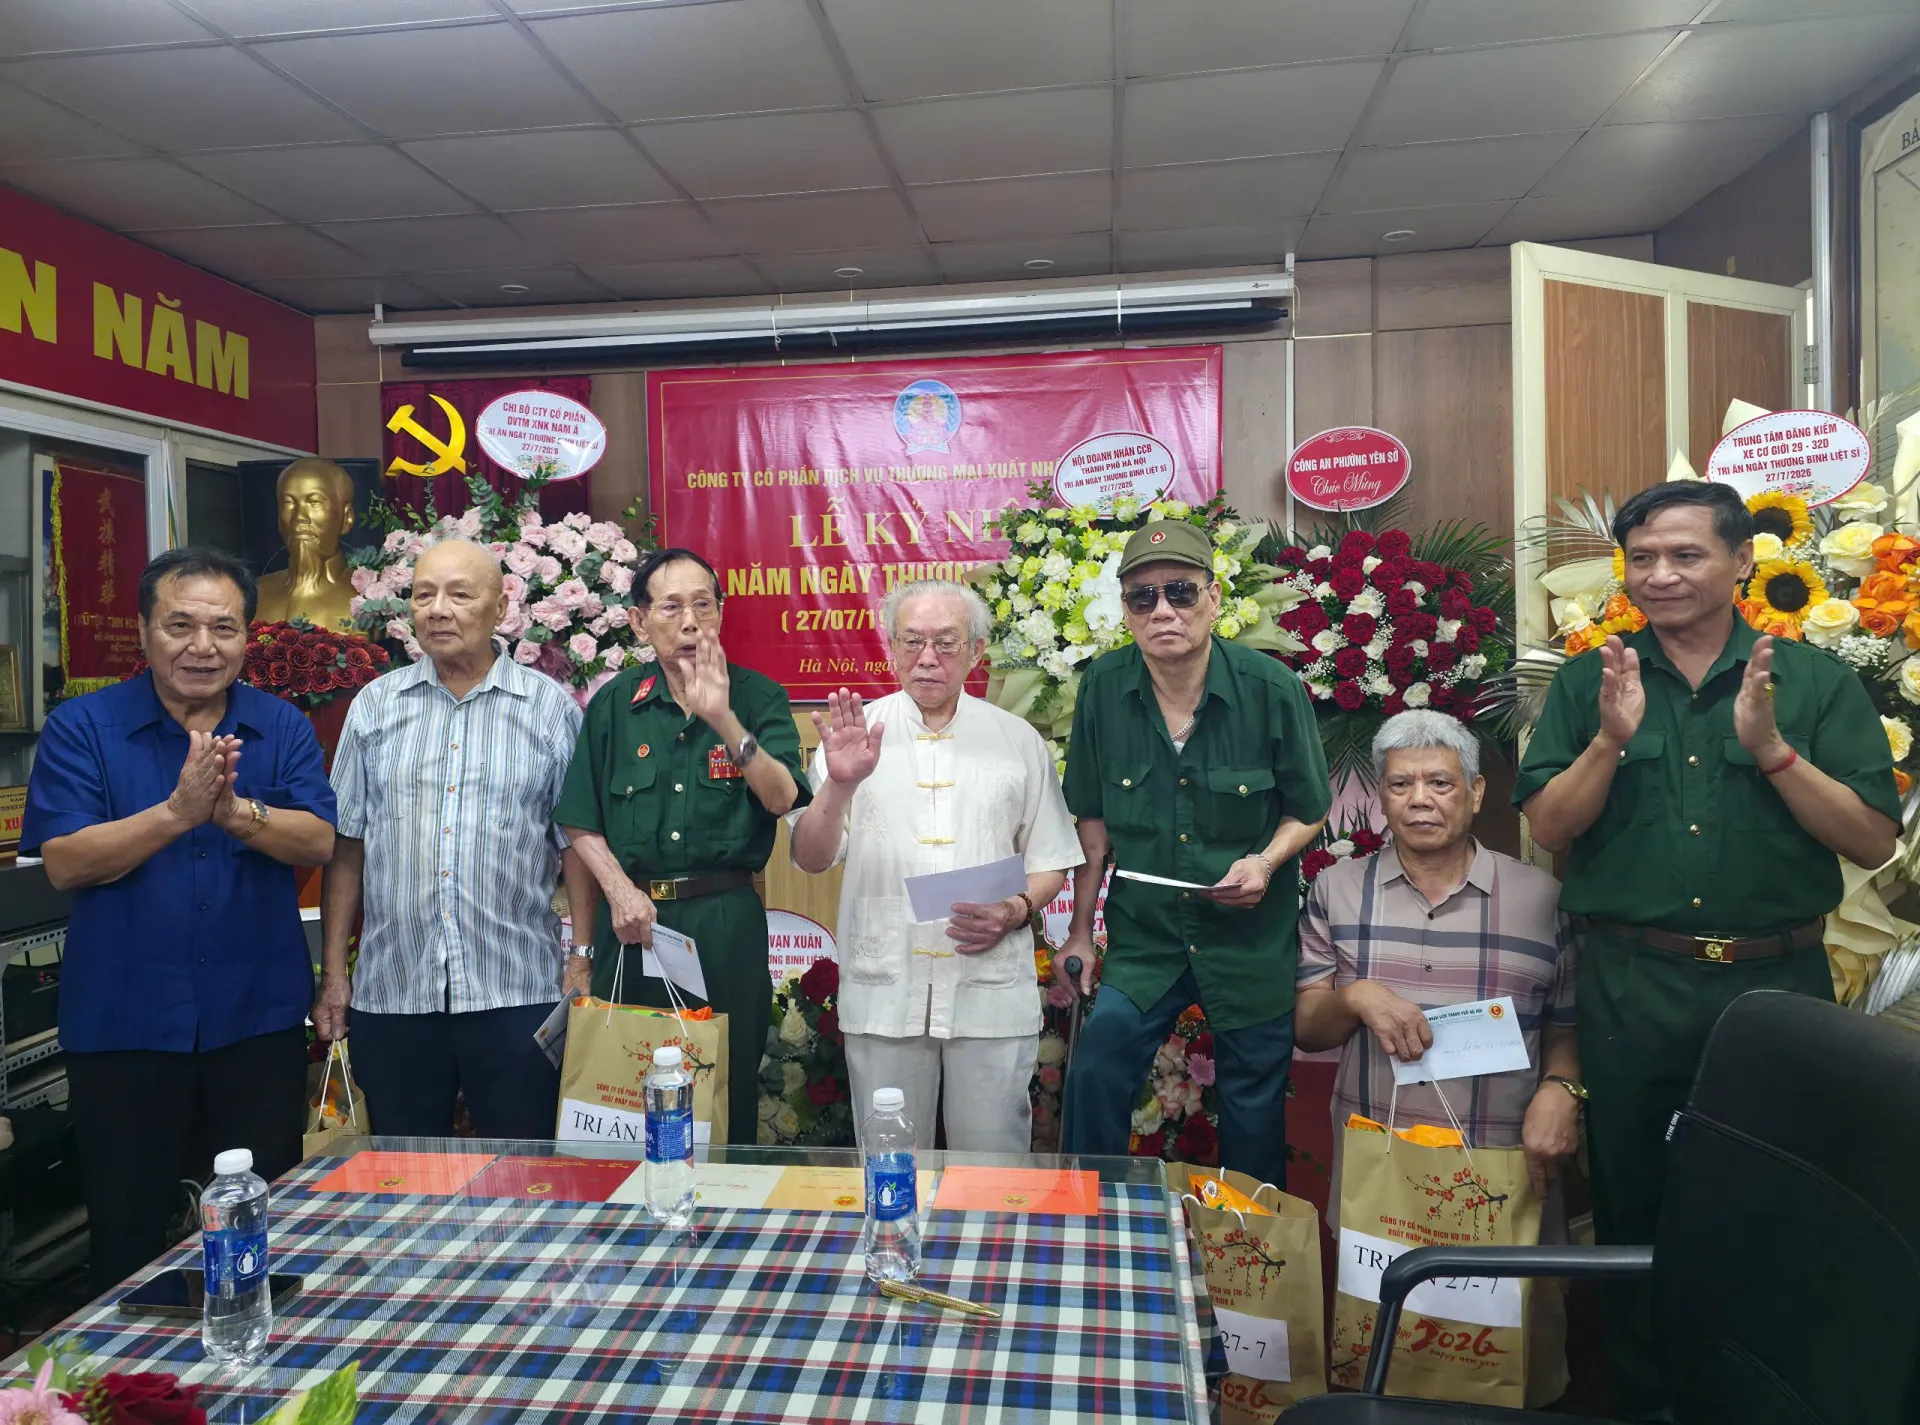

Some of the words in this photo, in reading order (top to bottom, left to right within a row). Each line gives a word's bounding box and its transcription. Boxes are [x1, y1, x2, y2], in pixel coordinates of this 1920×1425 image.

[1902, 118, 1920, 150] BẢ
[93, 281, 249, 400] NĂM
[503, 402, 516, 413] CHI
[519, 404, 530, 416] BỘ
[532, 406, 547, 417] CTY
[550, 407, 561, 419] CỔ
[507, 416, 530, 428] DVTM
[532, 419, 549, 431] XNK
[551, 422, 571, 434] NAM
[573, 424, 579, 435] Á
[1733, 433, 1762, 448] TRUNG
[1764, 430, 1783, 443] TÂM
[1786, 426, 1811, 440] ĐĂNG
[1813, 420, 1837, 436] KIỂM
[1072, 455, 1085, 467] HỘI
[1087, 451, 1112, 464] DOANH
[1114, 446, 1135, 459] NHÂN
[1137, 443, 1152, 455] CCB
[1294, 458, 1317, 472] CÔNG
[1319, 457, 1331, 470] AN
[1333, 452, 1367, 468] PHƯỜNG
[1369, 450, 1385, 465] YÊN
[1387, 447, 1399, 463] SỞ
[1717, 466, 1730, 476] TRI
[1732, 463, 1744, 474] ÂN
[1746, 461, 1768, 473] NGÀY
[1770, 456, 1804, 469] THƯƠNG
[1807, 453, 1828, 465] BINH
[1831, 450, 1848, 462] LIỆT
[1851, 447, 1860, 458] SĨ
[1743, 448, 1754, 460] XE
[1757, 446, 1769, 458] CƠ
[1771, 442, 1790, 456] GIỚI
[1792, 442, 1803, 453] 29
[1812, 438, 1829, 450] 32D
[687, 469, 728, 488] CÔNG
[732, 471, 749, 487] TY
[753, 465, 774, 487] CỔ
[778, 464, 819, 486] PHẦN
[988, 456, 1027, 480] XUẤT
[1031, 457, 1061, 477] NH
[1064, 481, 1074, 489] TRI
[1130, 468, 1145, 478] BINH
[1081, 464, 1105, 475] THÀNH
[1106, 460, 1121, 471] PHỐ
[1122, 459, 1132, 468] HÀ
[1134, 457, 1146, 467] NỘI
[1766, 468, 1812, 482] 27/7/2026
[1100, 481, 1133, 493] 27/7/2026
[1311, 475, 1340, 496] Chúc
[1343, 471, 1381, 498] Mừng
[789, 495, 848, 547] LỄ
[863, 499, 929, 546] KỶ
[727, 562, 790, 597] NĂM
[800, 560, 872, 594] NGÀY
[882, 561, 973, 593] THƯƠN
[799, 659, 821, 673] Hà
[827, 658, 859, 676] Nội,
[864, 659, 898, 677] ngày
[769, 935, 790, 951] VẠN
[793, 933, 822, 949] XUÂN
[785, 955, 804, 965] BINH
[574, 1111, 603, 1134] TRI
[608, 1116, 639, 1142] ÂN
[1380, 1215, 1396, 1226] CÔNG
[1461, 1233, 1471, 1241] TM
[1411, 1316, 1509, 1357] 2026
[1429, 1348, 1456, 1362] happy
[1459, 1356, 1477, 1365] new
[1474, 1359, 1501, 1370] year
[1221, 1379, 1285, 1410] 026
